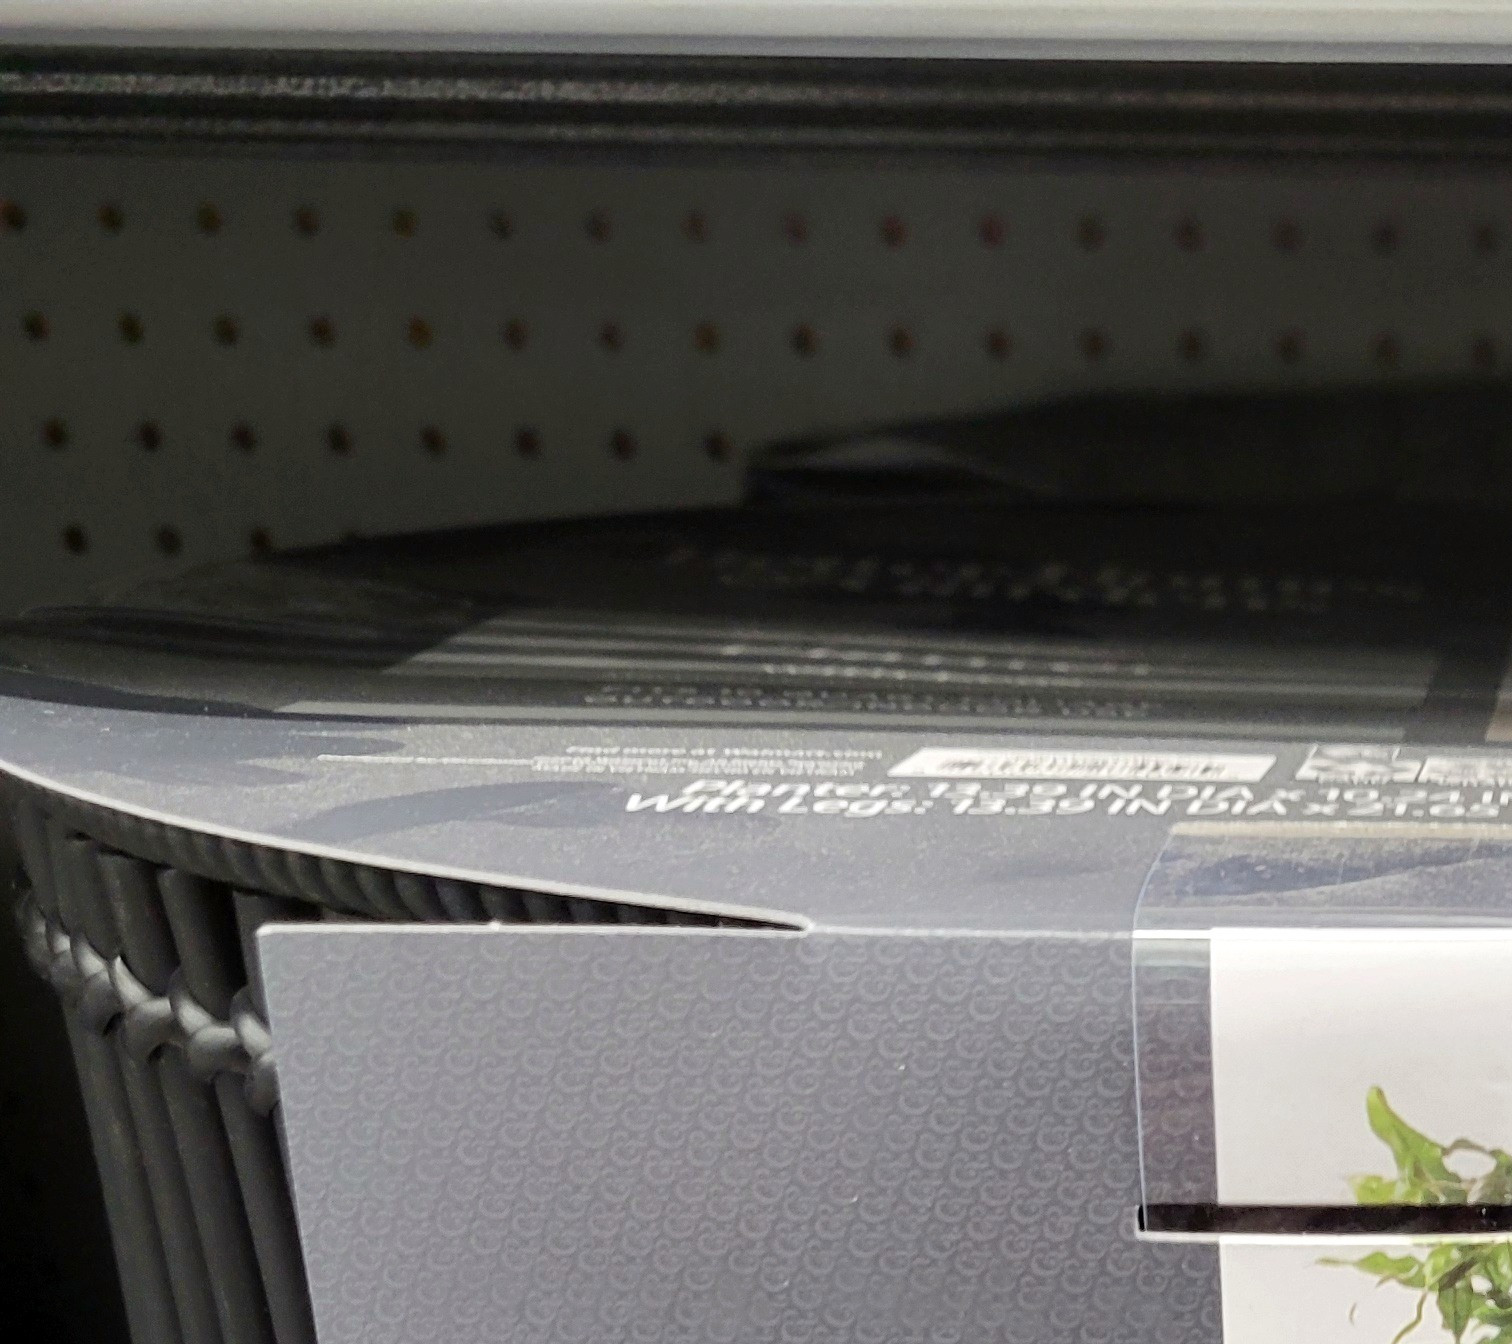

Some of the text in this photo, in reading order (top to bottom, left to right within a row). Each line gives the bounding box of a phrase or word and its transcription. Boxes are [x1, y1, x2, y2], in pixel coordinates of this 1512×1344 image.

[682, 779, 909, 797] Planter:
[1079, 782, 1143, 799] IN
[1157, 784, 1254, 801] DIA
[624, 793, 765, 813] With
[776, 797, 933, 818] Legs:
[1106, 799, 1171, 815] IN
[1186, 800, 1287, 816] DIA
[1303, 803, 1338, 816] x
